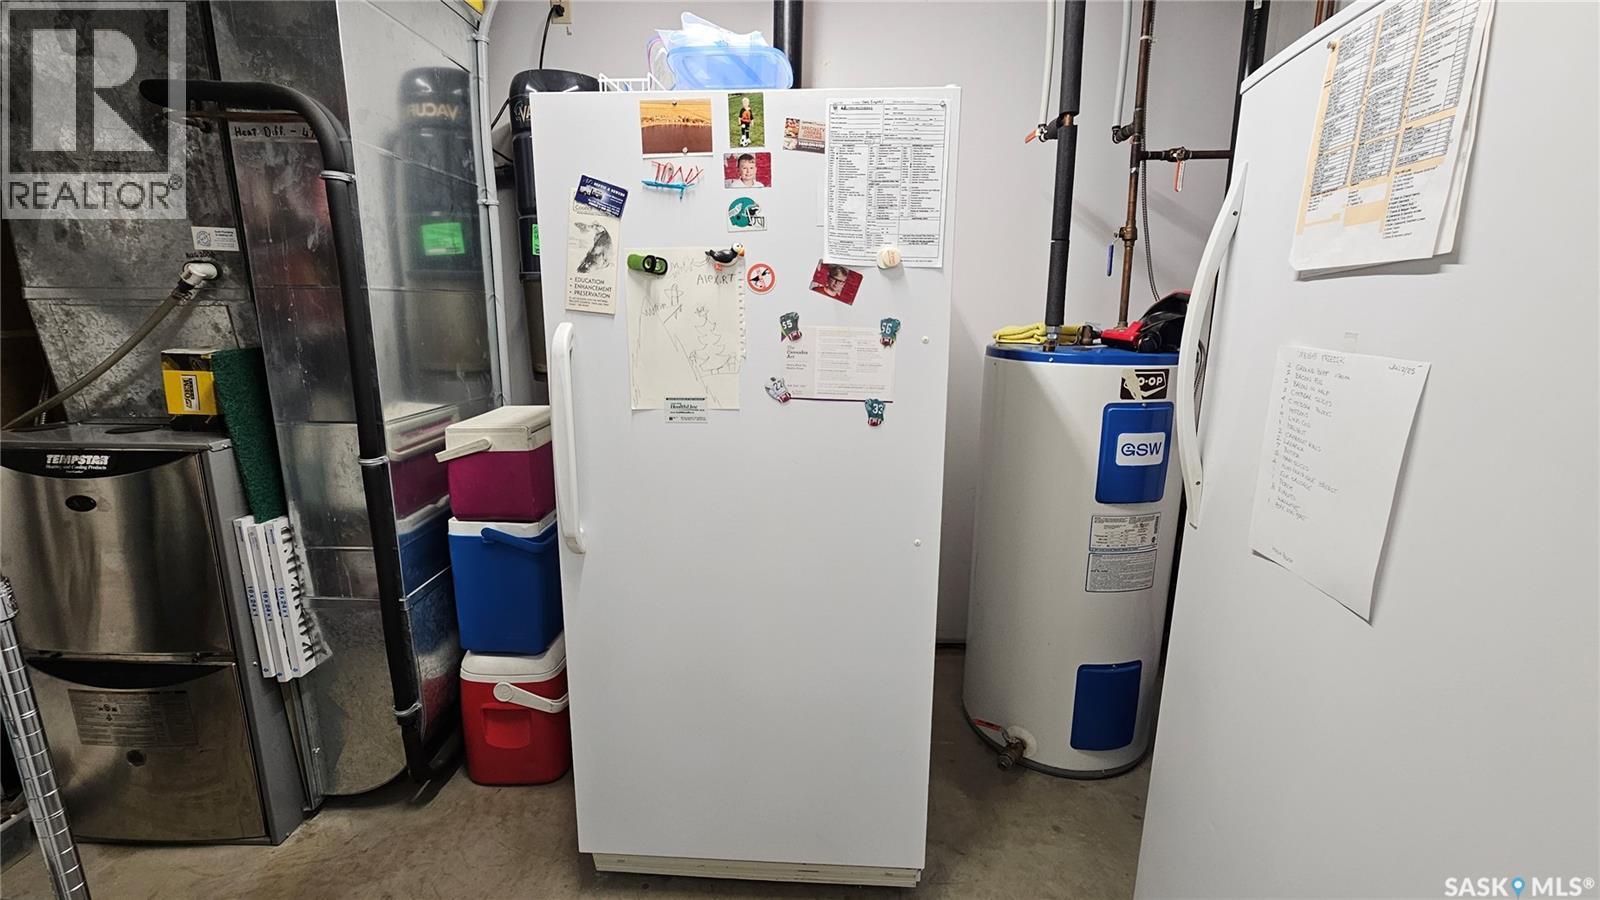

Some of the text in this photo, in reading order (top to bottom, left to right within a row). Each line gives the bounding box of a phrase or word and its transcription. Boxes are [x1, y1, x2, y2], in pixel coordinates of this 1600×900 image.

[574, 277, 605, 285] EDUCATION
[574, 284, 612, 292] ENHANCEMENT
[573, 290, 611, 299] PRESERVATION
[782, 320, 793, 330] 55
[1121, 442, 1162, 457] GSW
[46, 454, 110, 465] TEMPSTAR
